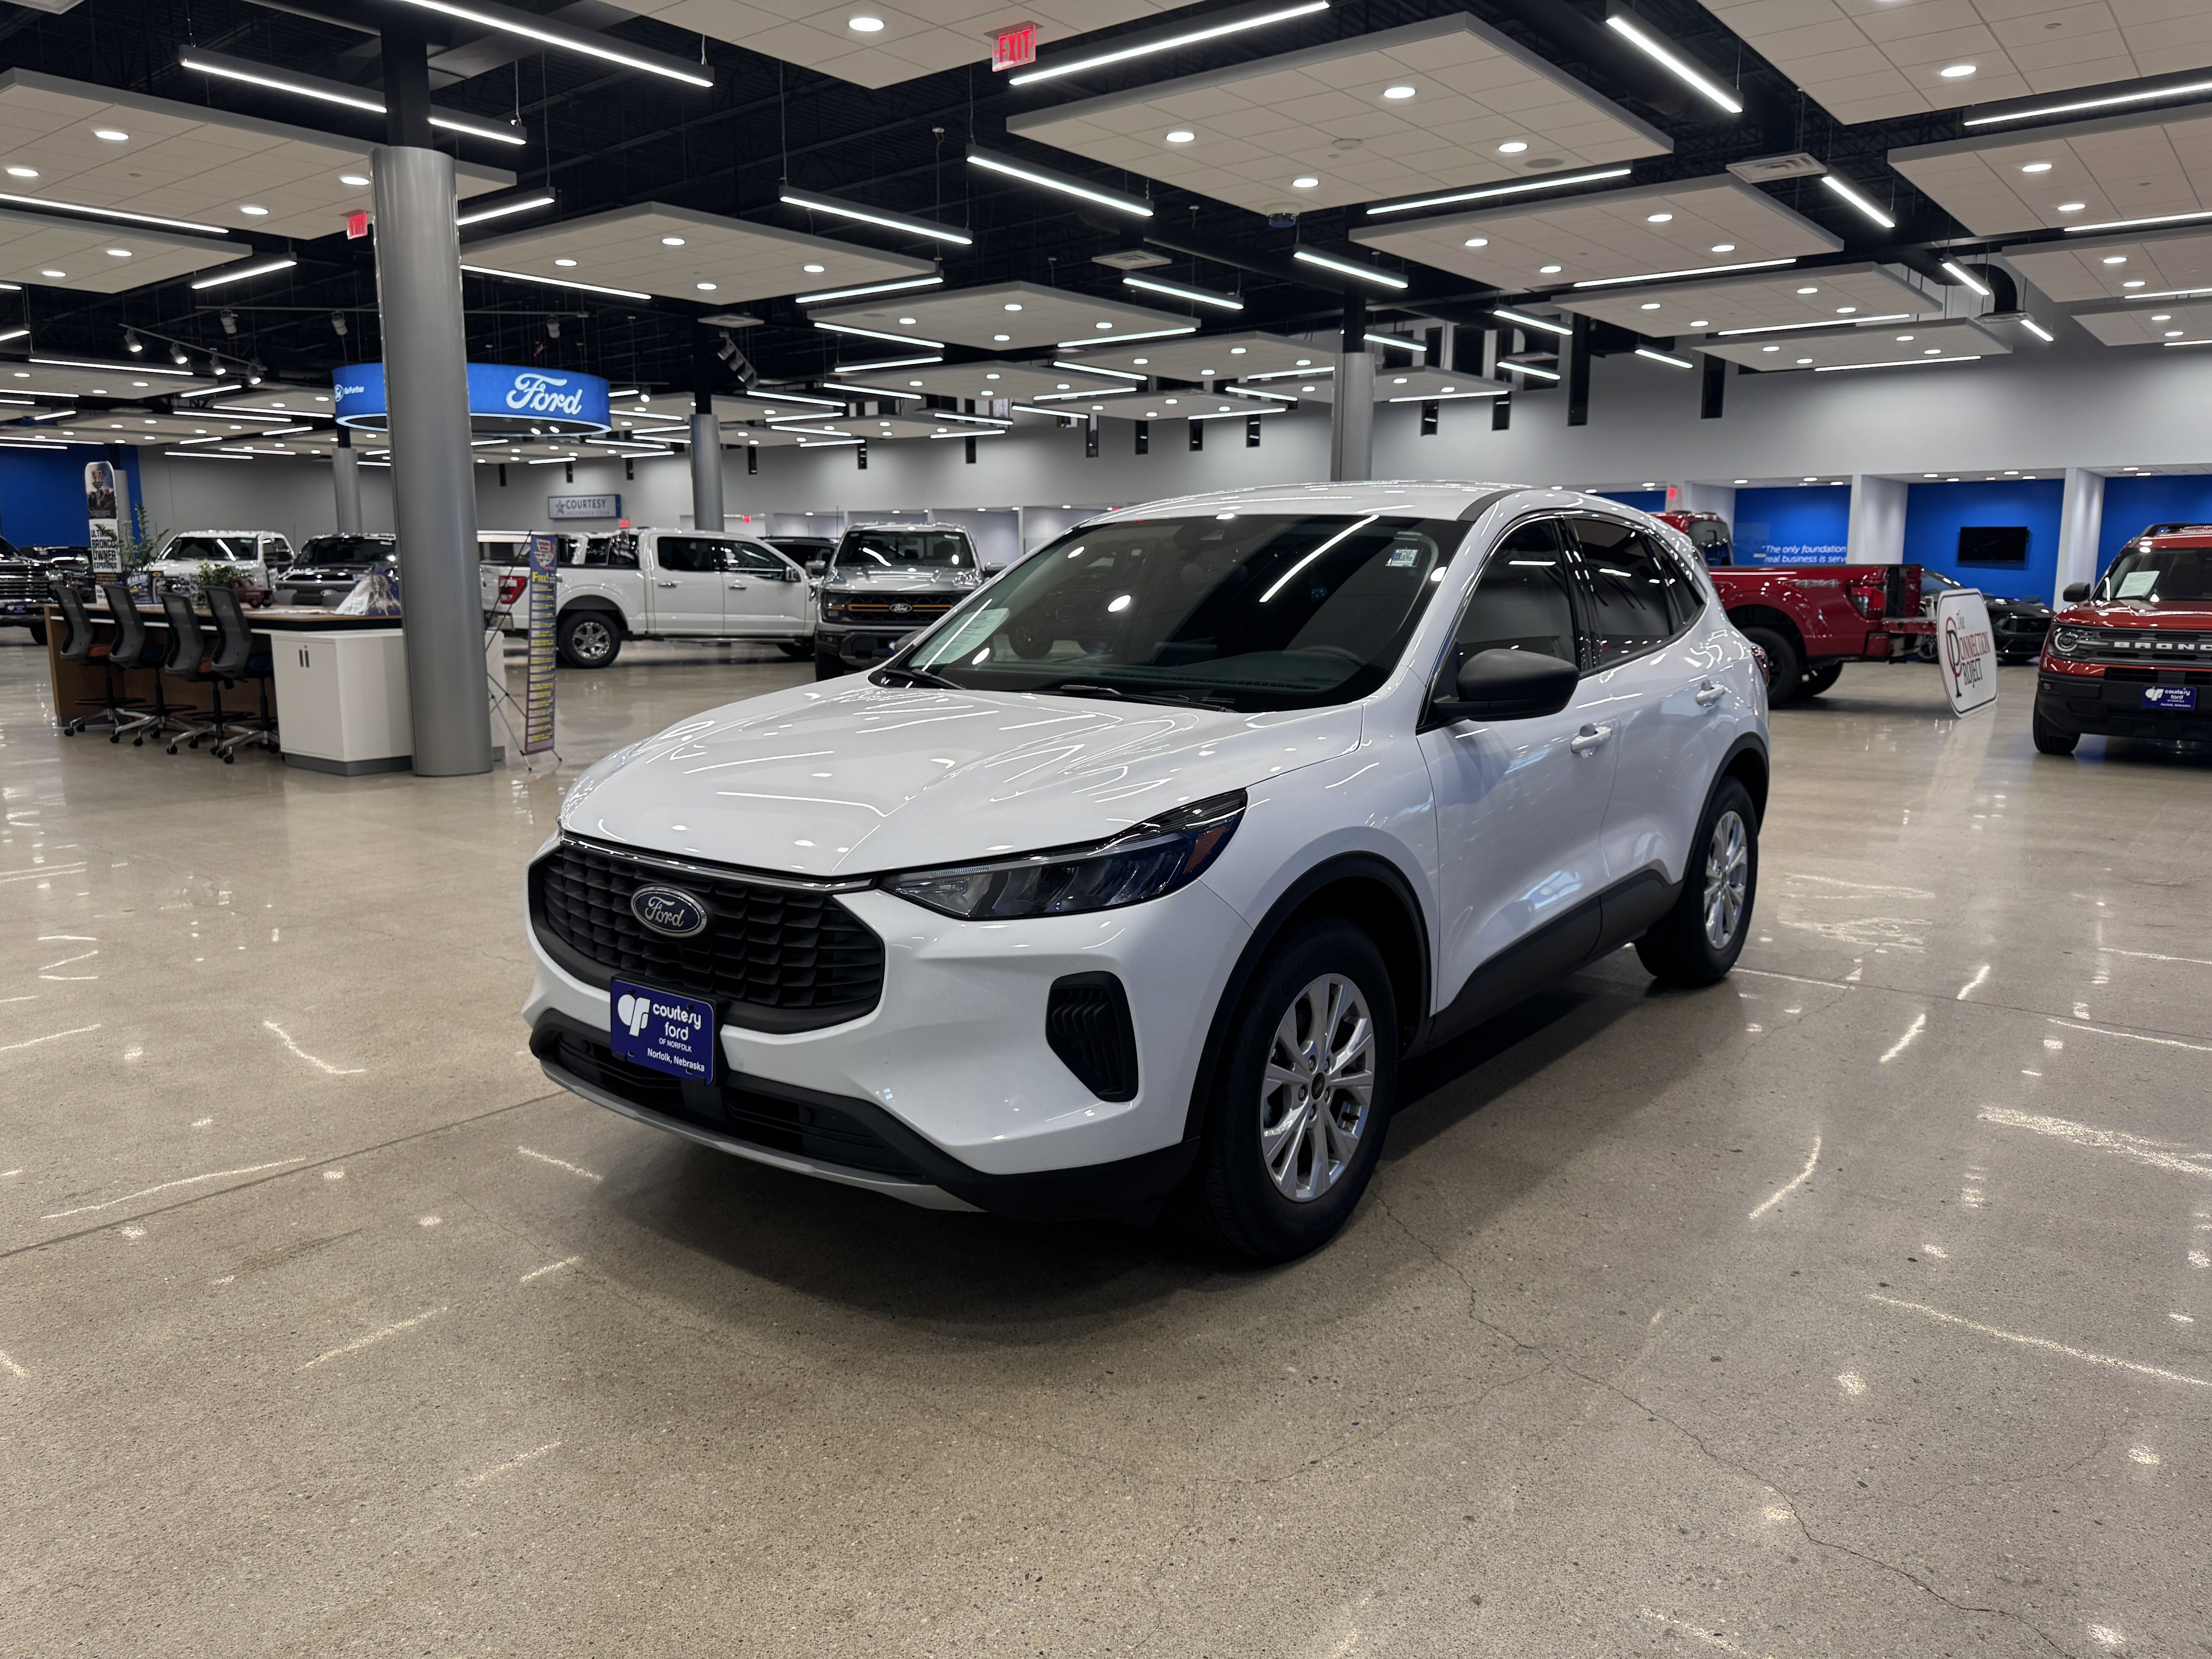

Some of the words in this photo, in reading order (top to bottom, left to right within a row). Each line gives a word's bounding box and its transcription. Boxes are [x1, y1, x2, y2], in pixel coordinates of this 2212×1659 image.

[999, 29, 1031, 62] EXIT
[506, 373, 582, 415] Ford
[565, 499, 606, 509] COURTESY
[93, 550, 117, 561] OWNER
[1764, 554, 1781, 563] real
[1782, 555, 1818, 563] business
[1782, 544, 1801, 554] only
[1801, 544, 1847, 554] foundation
[1956, 610, 1965, 630] The
[645, 896, 685, 927] Ford
[653, 1003, 701, 1030] courtesy
[665, 1022, 689, 1041] ford
[667, 1040, 692, 1053] NORFOLK
[647, 1048, 672, 1064] Norfolk,
[674, 1055, 705, 1072] Nebraska
